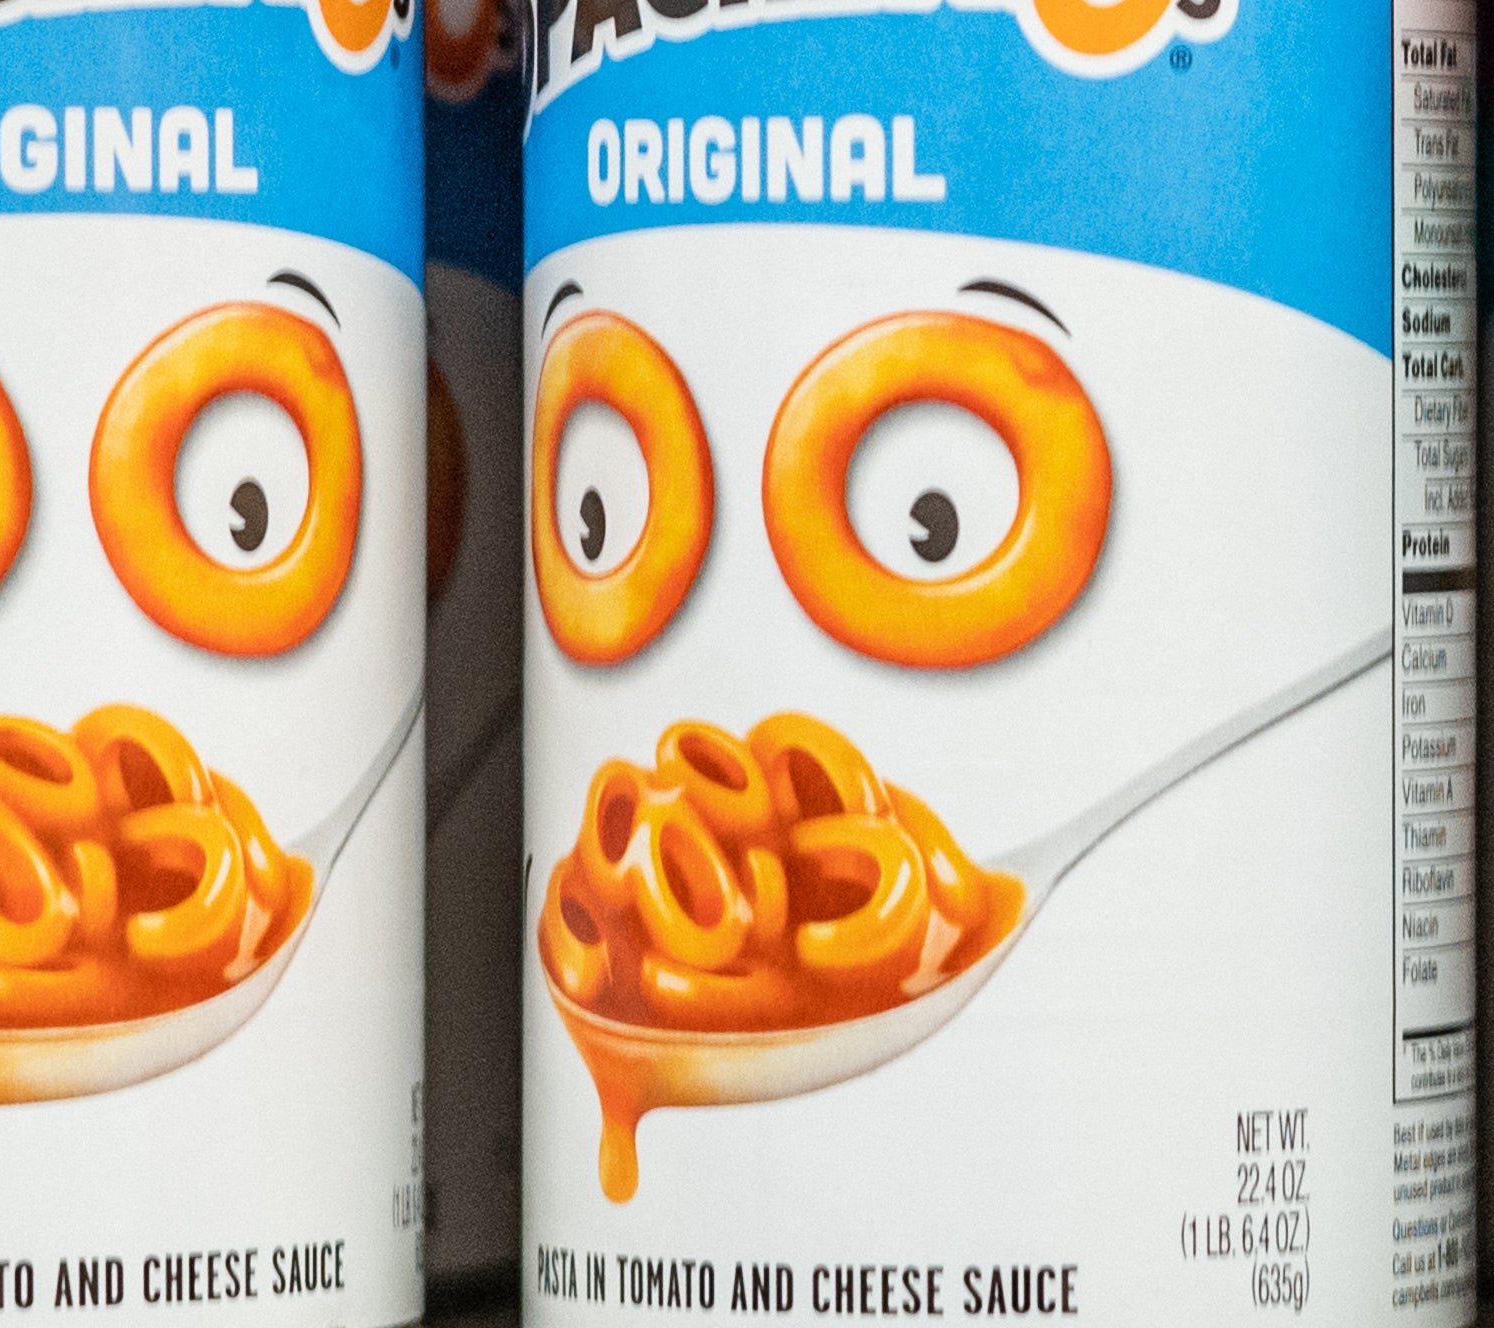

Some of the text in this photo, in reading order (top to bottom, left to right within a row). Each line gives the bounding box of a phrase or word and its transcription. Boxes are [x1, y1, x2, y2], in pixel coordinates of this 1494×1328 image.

[588, 114, 946, 204] ORIGINAL
[1402, 308, 1451, 335] Sodium
[1402, 528, 1450, 557] Protein
[1402, 643, 1448, 672] Calcium
[1402, 689, 1426, 717] Iron
[1237, 1111, 1273, 1154] NET
[1237, 1162, 1276, 1206] 22.4
[1206, 1215, 1235, 1257] LB.
[1242, 1214, 1270, 1256] 6.4
[537, 1244, 1077, 1315] PASTA IN TOMATO AND CHEESE SAUCE
[1252, 1256, 1310, 1314] (635g)
